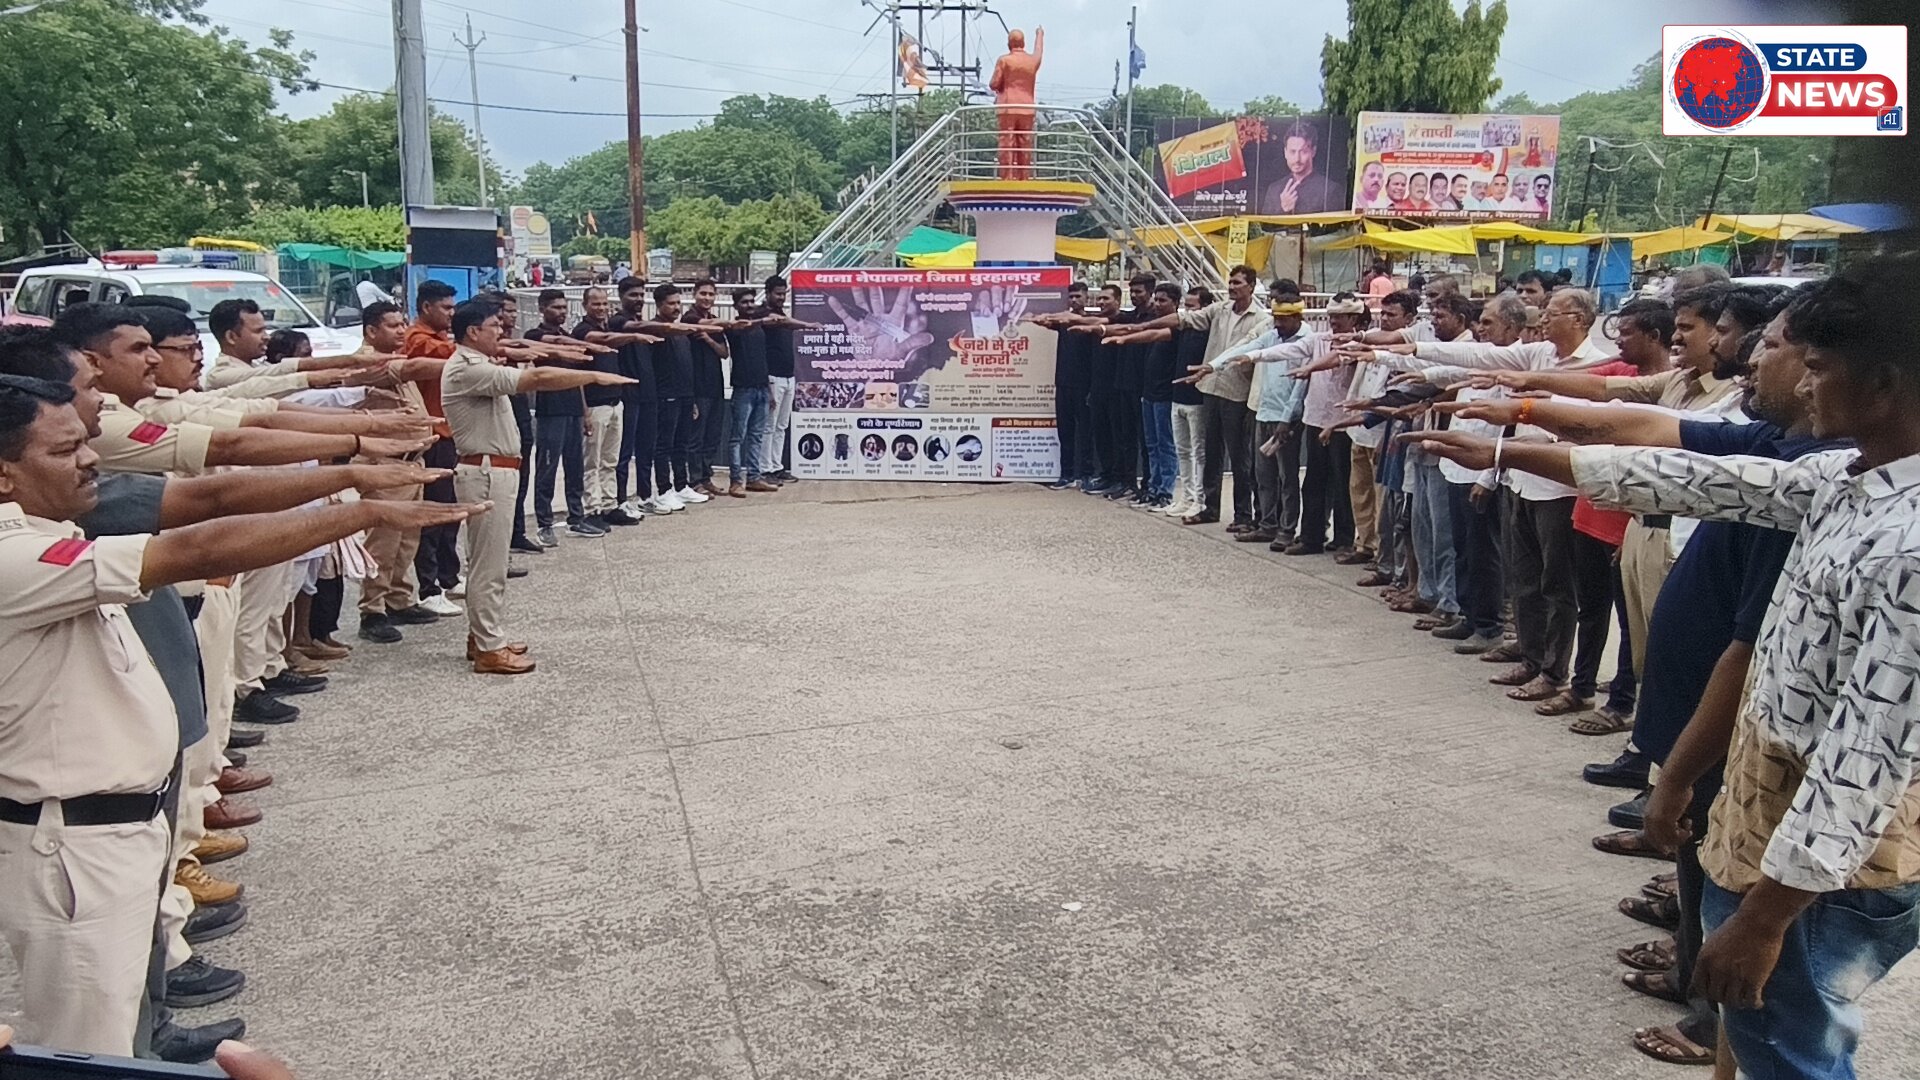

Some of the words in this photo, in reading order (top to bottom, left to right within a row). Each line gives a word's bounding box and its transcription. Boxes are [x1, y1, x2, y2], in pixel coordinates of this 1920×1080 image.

[1421, 124, 1453, 138] ताप्ती
[815, 273, 852, 283] थाना
[856, 271, 923, 283] नेपानगर
[926, 270, 966, 283] जिला
[970, 272, 1041, 286] बुरहानपुर
[824, 332, 830, 345] है
[963, 336, 989, 351] नशे
[991, 336, 1004, 351] से
[1007, 336, 1030, 356] दूरी
[960, 351, 969, 366] है
